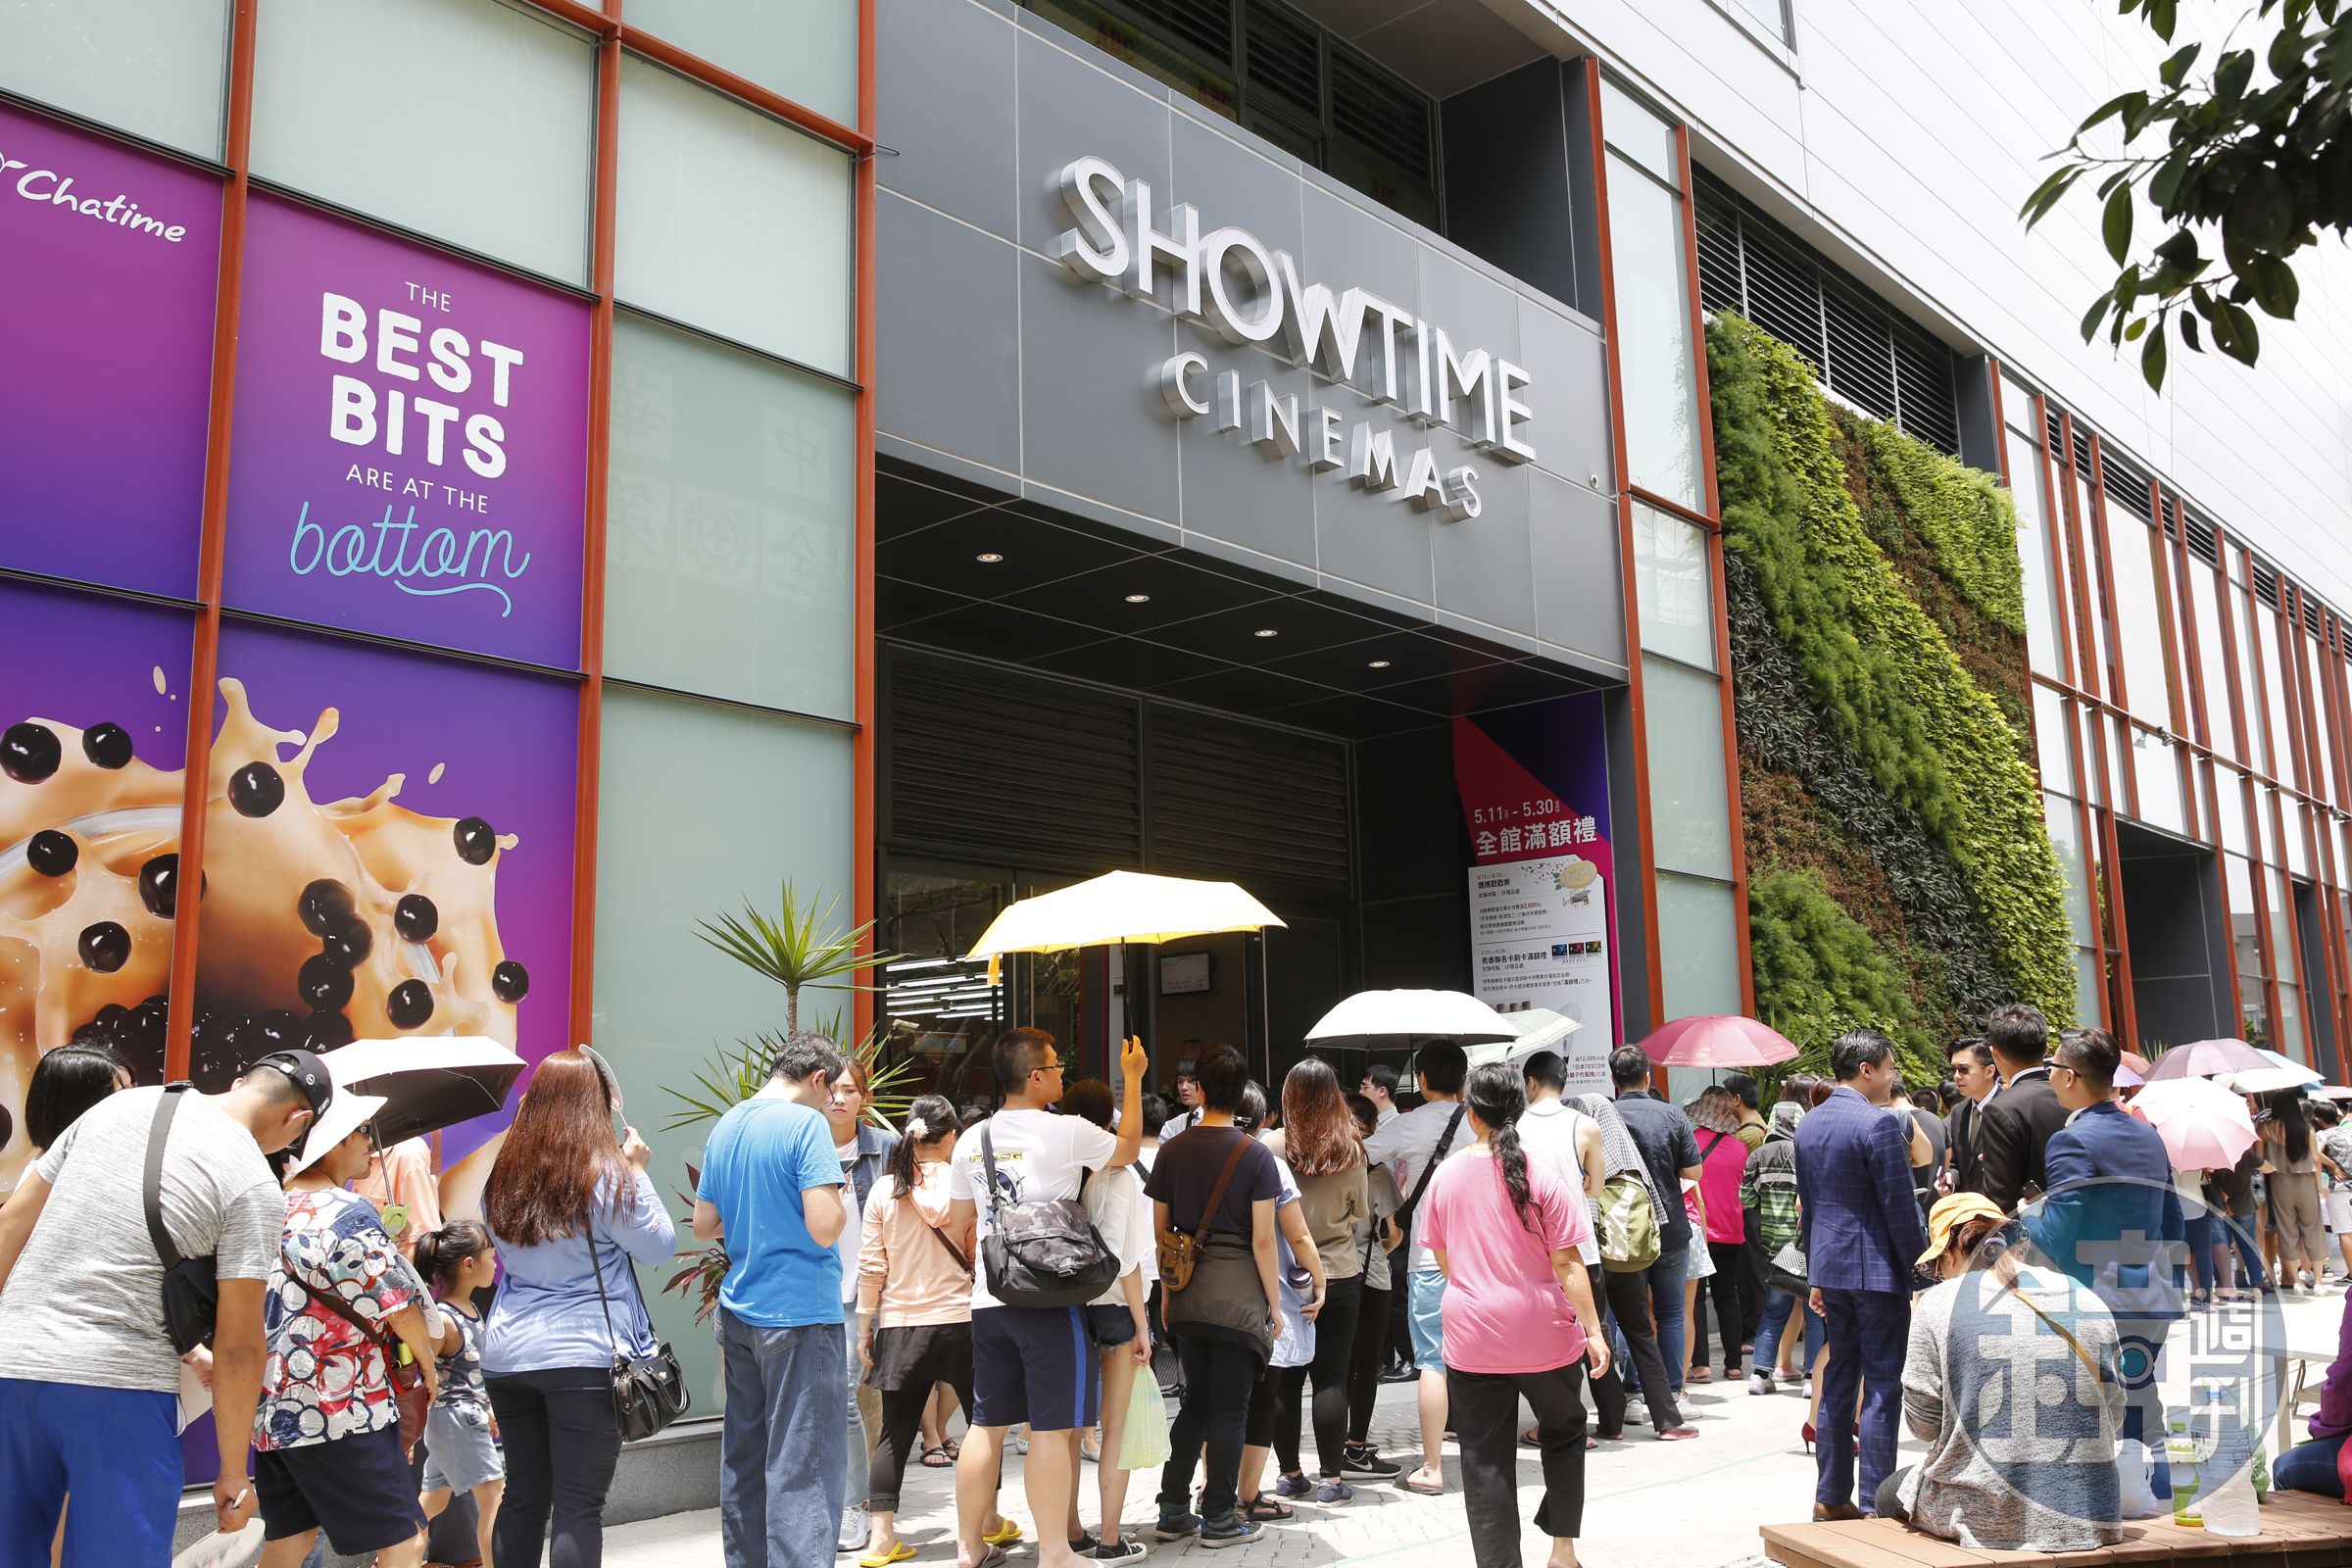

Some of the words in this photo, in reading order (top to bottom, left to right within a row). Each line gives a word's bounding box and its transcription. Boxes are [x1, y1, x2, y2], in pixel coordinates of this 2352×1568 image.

[17, 170, 186, 244] Chatime
[405, 281, 453, 313] THE
[1060, 155, 1537, 466] SHOWTIME
[320, 291, 523, 408] BEST
[329, 374, 508, 479] BITS
[1160, 351, 1483, 521] CINEMAS
[345, 464, 394, 493] ARE
[402, 477, 435, 501] AT
[443, 485, 490, 515] THE
[290, 501, 531, 579] bottom
[1474, 806, 1502, 823] 5.11
[1523, 799, 1554, 817] 5.30
[1476, 815, 1597, 857] 全館滿額禮
[969, 1152, 1023, 1163] FCG
